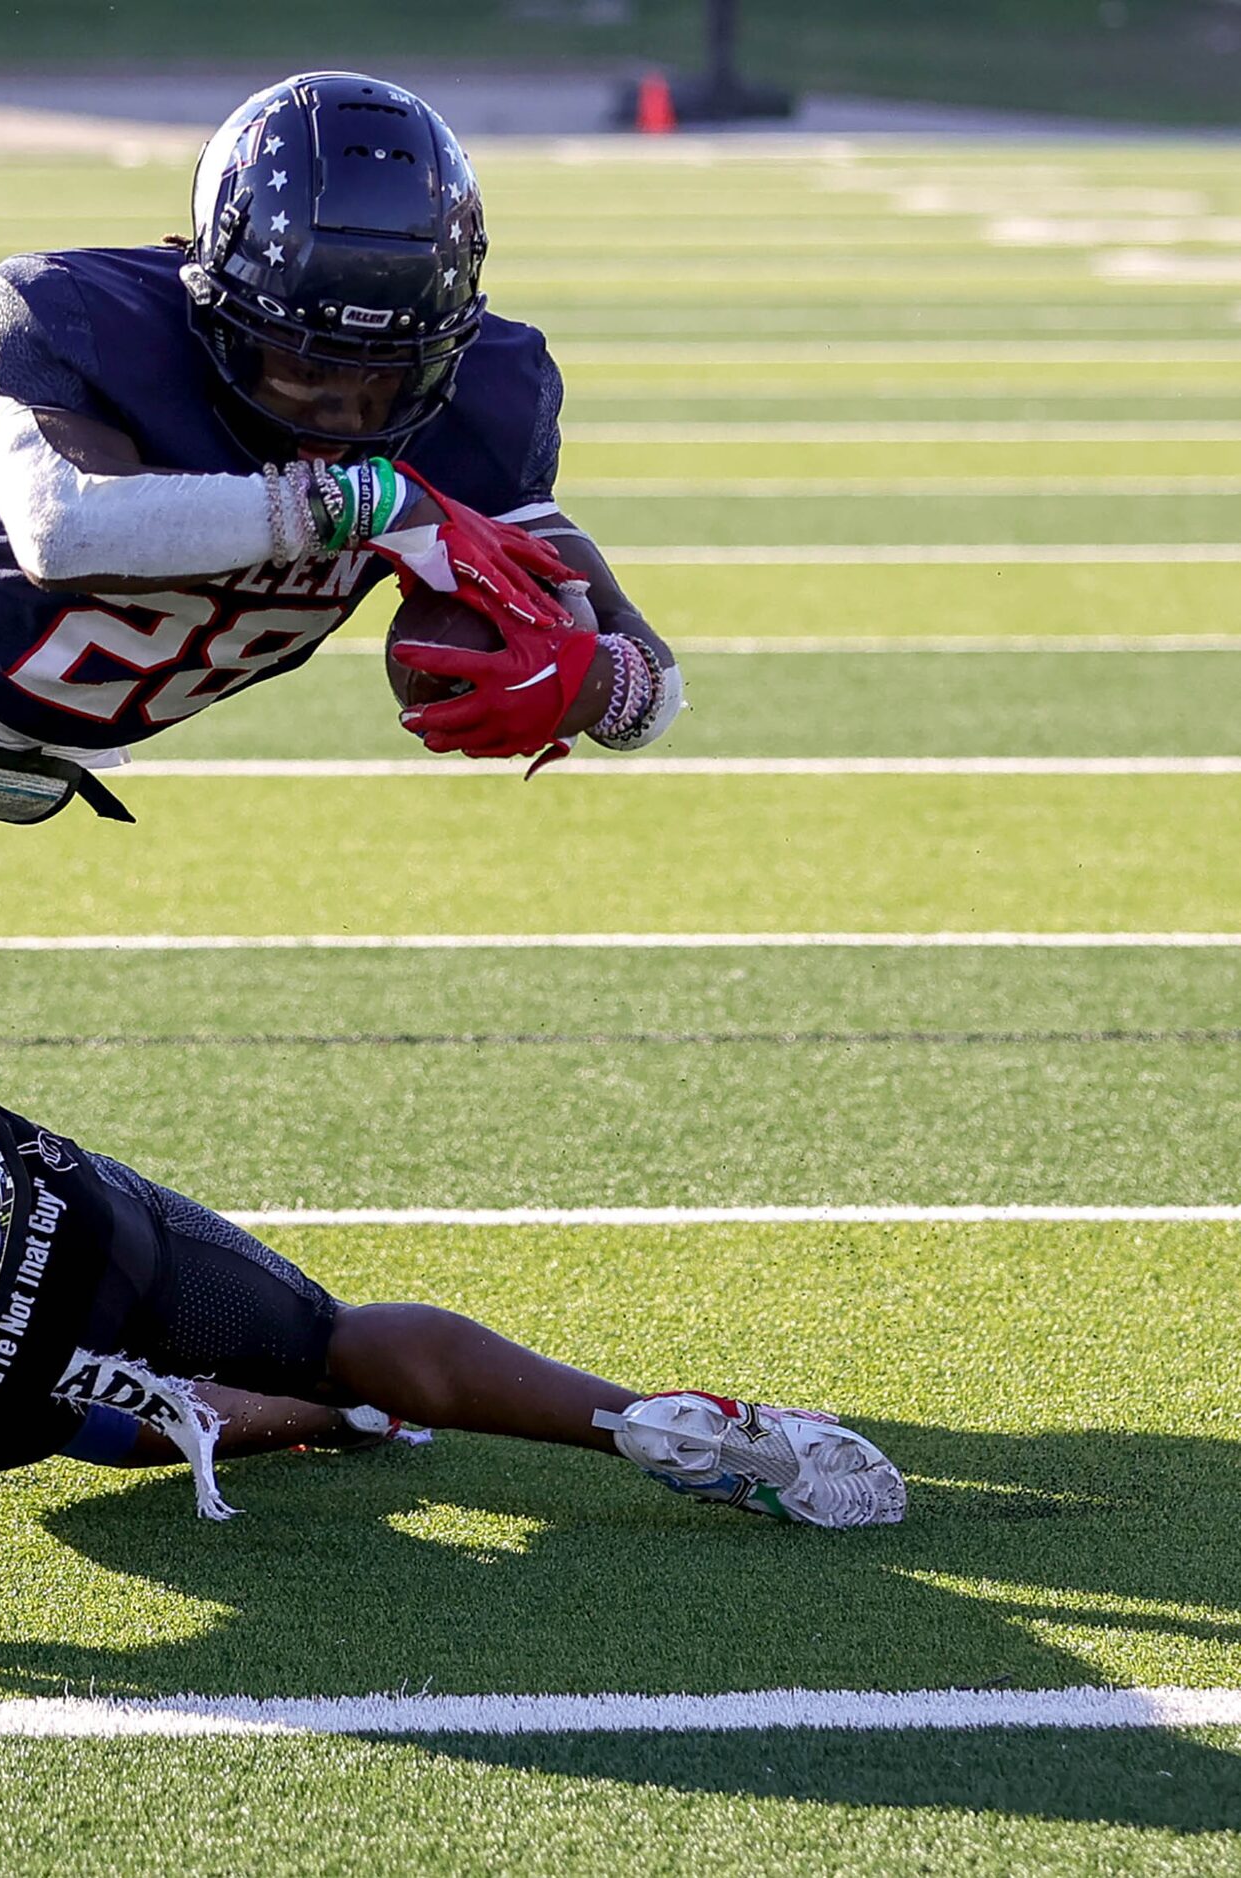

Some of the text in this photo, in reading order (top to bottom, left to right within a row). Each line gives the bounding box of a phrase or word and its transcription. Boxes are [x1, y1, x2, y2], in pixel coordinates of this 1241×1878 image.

[345, 309, 389, 325] ALLEN
[362, 485, 371, 500] UP
[207, 550, 376, 598] LEN
[2, 590, 348, 724] 28
[16, 1234, 52, 1288] That
